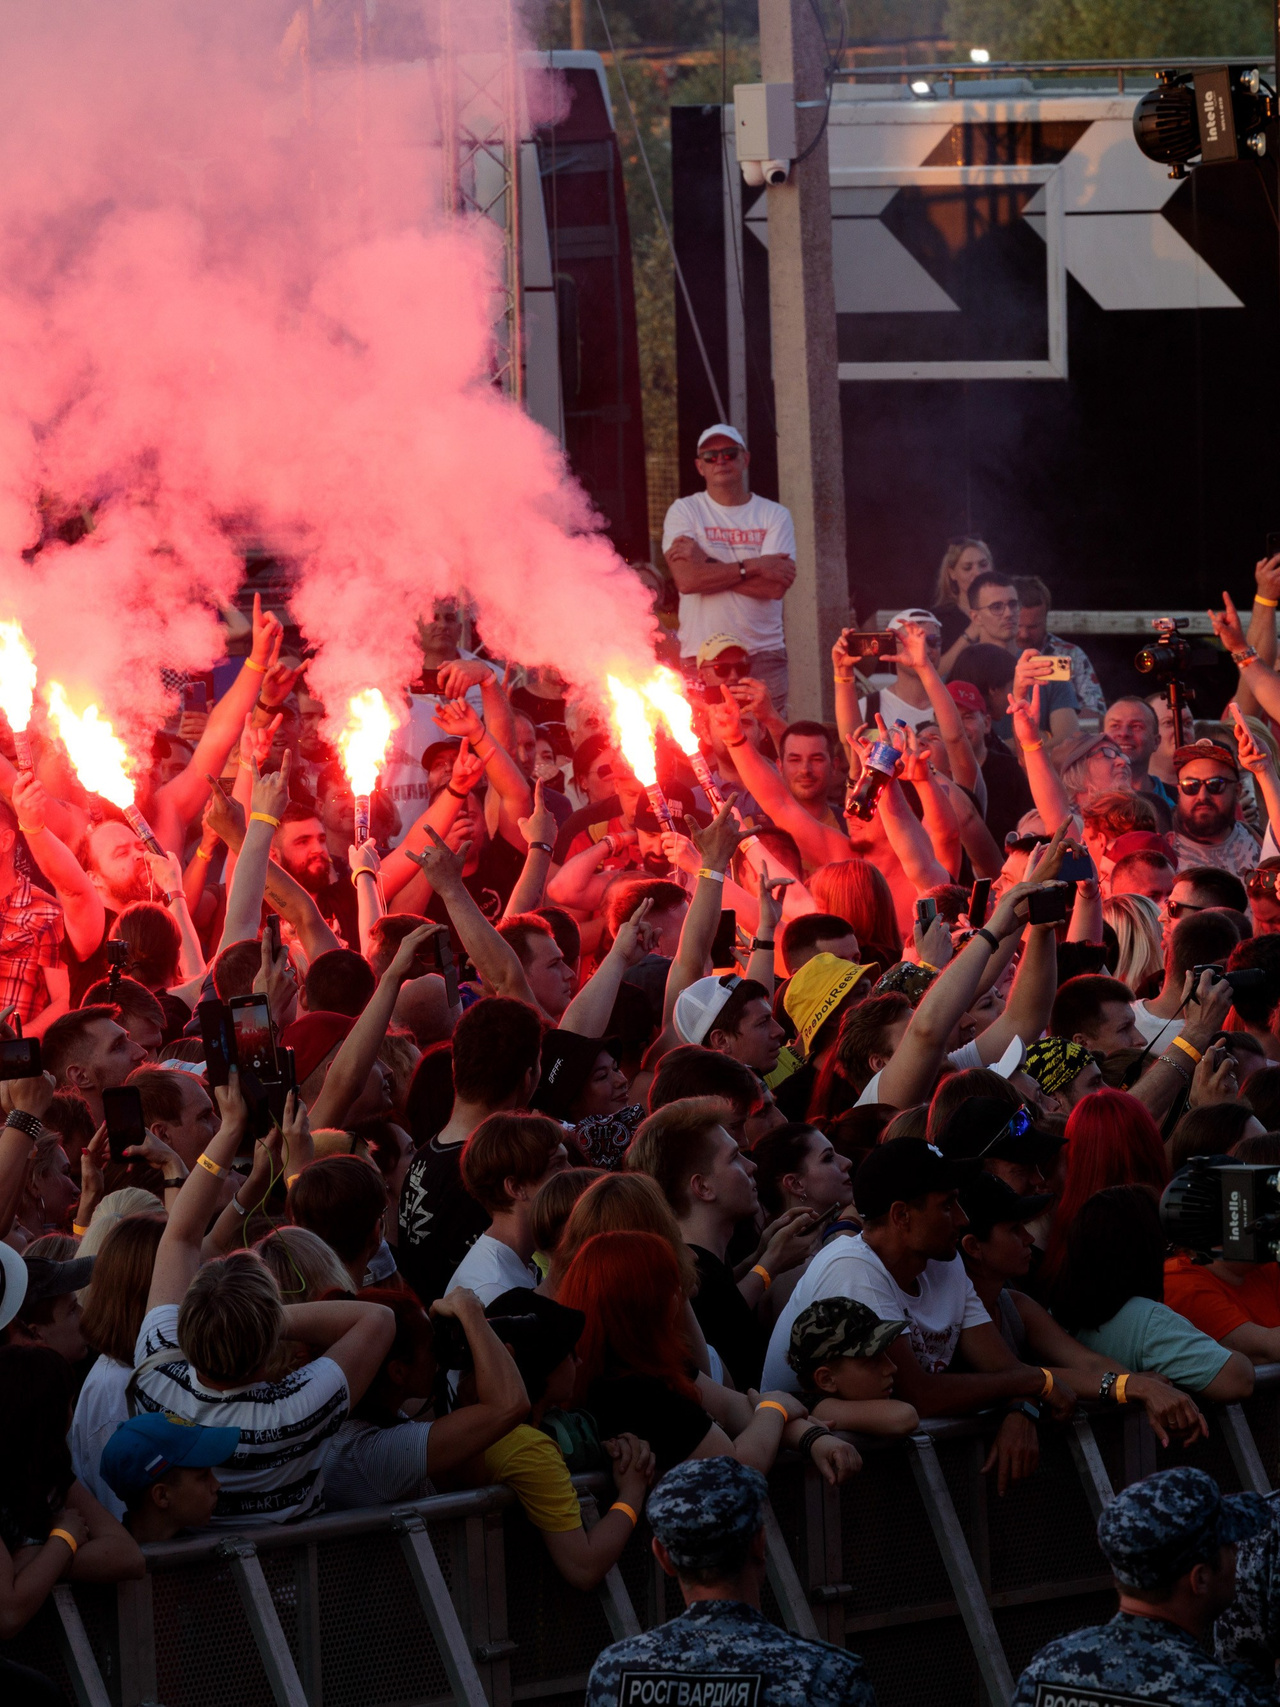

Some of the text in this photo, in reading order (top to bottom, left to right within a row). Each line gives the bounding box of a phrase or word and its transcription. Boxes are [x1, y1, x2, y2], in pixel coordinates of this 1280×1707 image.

[1204, 91, 1218, 142] intella
[1229, 1191, 1240, 1241] intella
[629, 1680, 750, 1707] РОСГВАРДИЯ
